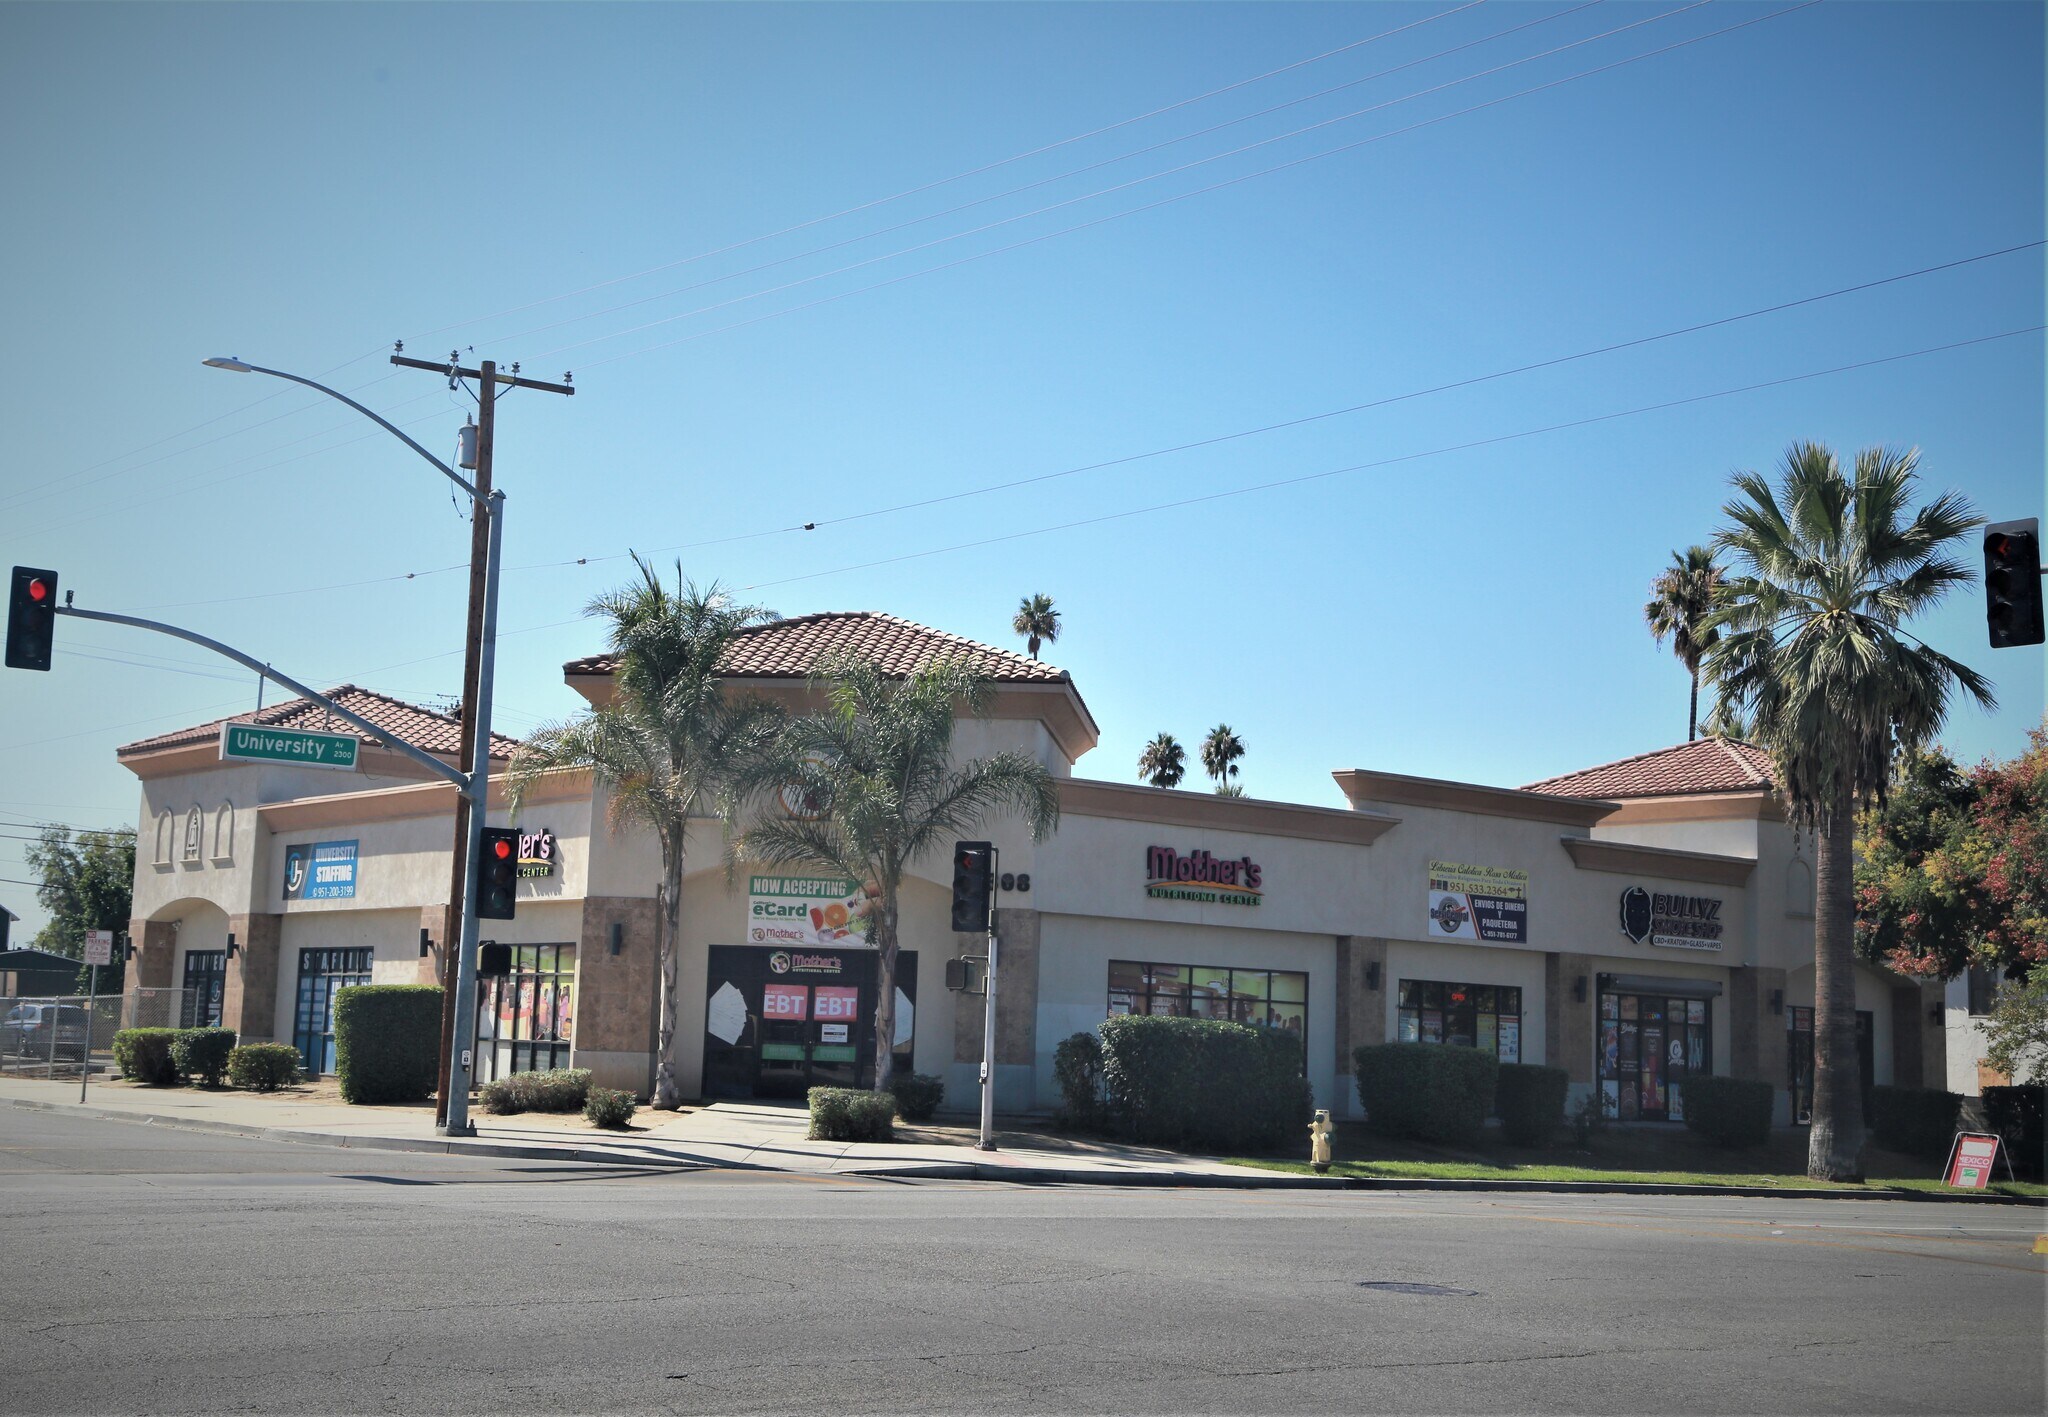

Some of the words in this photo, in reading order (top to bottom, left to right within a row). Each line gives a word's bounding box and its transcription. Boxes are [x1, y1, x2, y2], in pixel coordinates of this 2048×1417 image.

[237, 732, 325, 759] University
[333, 751, 352, 759] 2300
[316, 846, 356, 862] UNIVERSITY
[522, 867, 549, 878] CENTER
[1147, 845, 1262, 888] Mother's
[317, 865, 352, 883] STAFFING
[318, 886, 354, 898] 951-200-3199
[753, 878, 780, 894] NOW
[782, 879, 847, 896] ACCEPTING
[1449, 881, 1507, 896] 951.533.2364
[1149, 888, 1220, 902] NUTRITIONAL
[1222, 894, 1262, 906] CENTER
[752, 903, 807, 917] eCard
[1474, 899, 1495, 909] ENVIOS
[1496, 901, 1504, 910] DE
[1504, 902, 1525, 912] DINERO
[1652, 893, 1722, 920] BULLYZ
[1497, 911, 1503, 919] Y
[1482, 918, 1518, 929] PAQUETERIA
[1652, 917, 1693, 936] SMOKE
[1693, 922, 1723, 939] SHOP
[766, 928, 804, 939] Mother's
[1654, 936, 1665, 944] CBD
[1707, 941, 1722, 949] VAPES
[792, 954, 842, 968] Mother's
[763, 995, 805, 1014] EBT
[815, 997, 857, 1016] EBT
[1959, 1156, 1990, 1165] MEXICO
